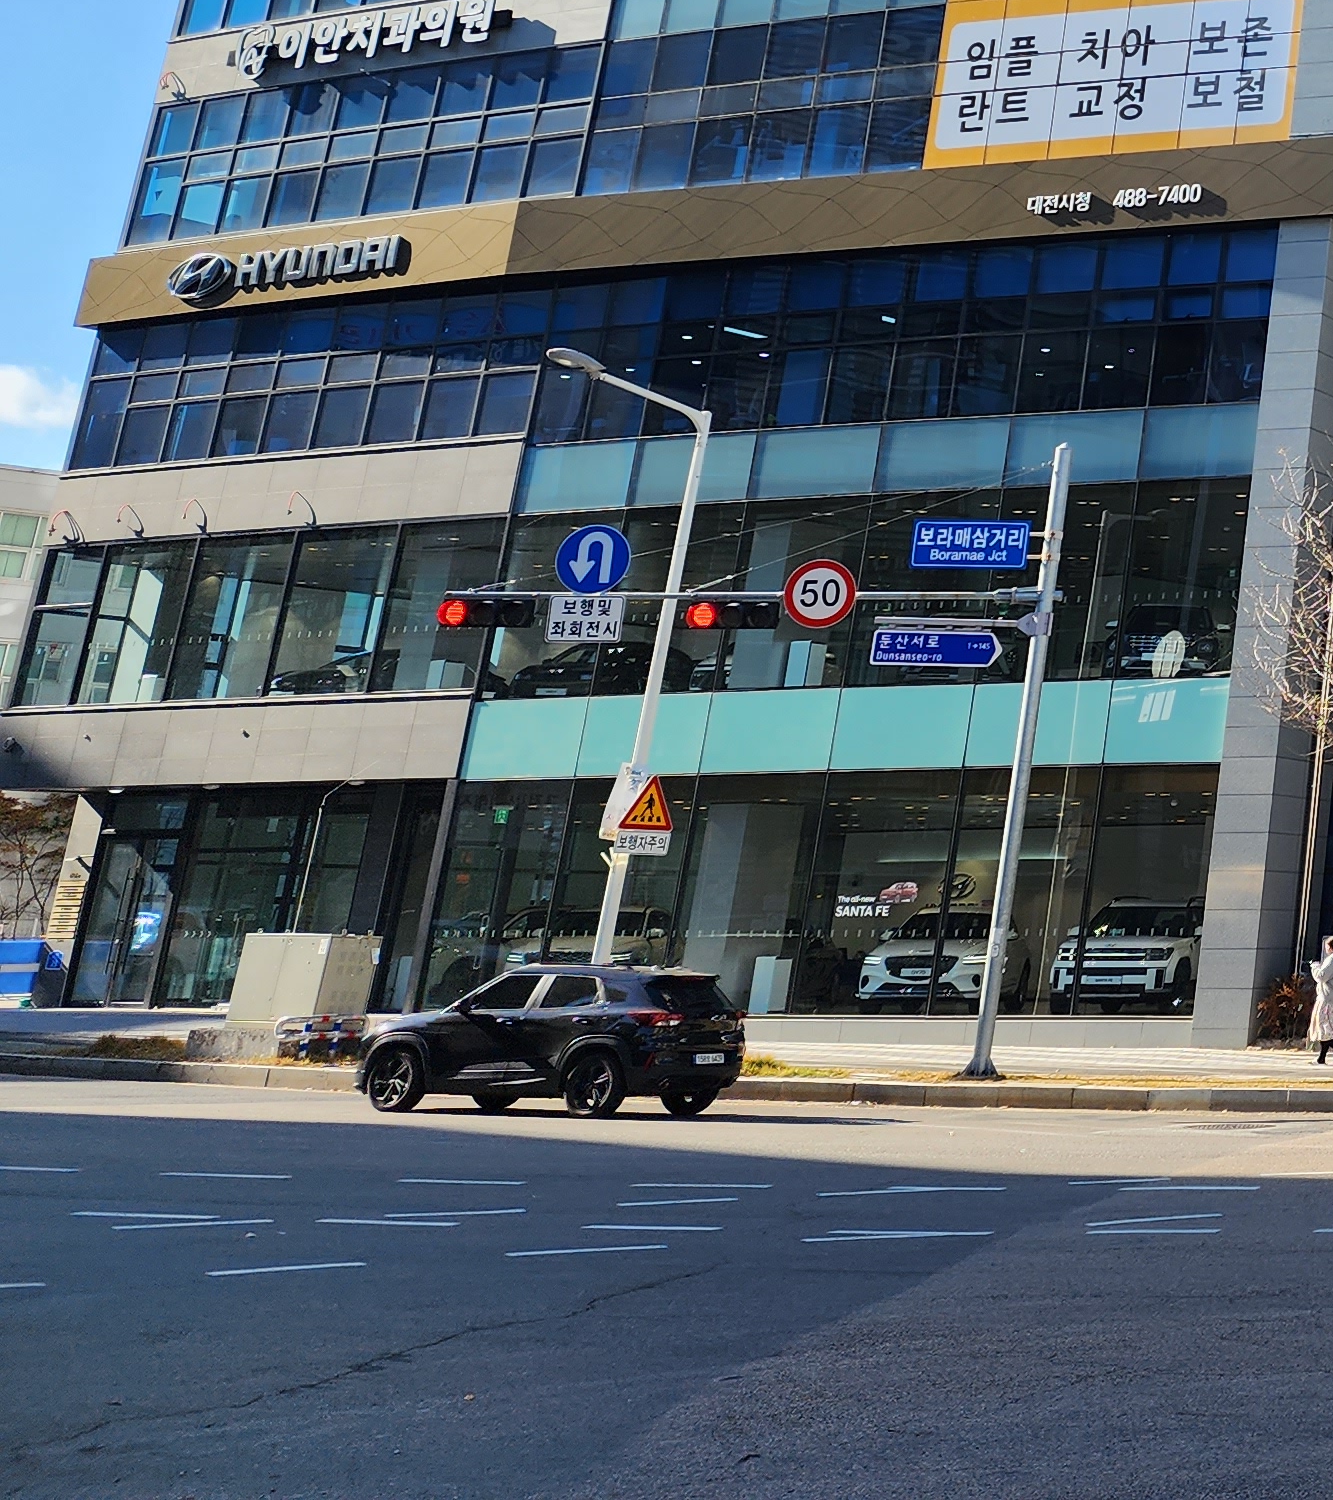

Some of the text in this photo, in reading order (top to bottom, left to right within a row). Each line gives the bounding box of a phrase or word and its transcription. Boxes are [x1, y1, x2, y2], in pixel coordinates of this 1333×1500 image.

[1077, 25, 1156, 69] 치아
[1192, 16, 1274, 58] 보존
[1068, 80, 1147, 121] 교정
[1186, 70, 1266, 113] 보철
[1026, 183, 1202, 215] 대전시청 488-7400
[234, 235, 402, 288] HYUNDAI
[917, 527, 1025, 549] 보라매삼거리
[930, 549, 1007, 561] Boramae Jct
[799, 578, 841, 608] 50
[550, 621, 618, 638] 좌회전시
[879, 635, 940, 649] 둔산서로
[876, 651, 942, 662] Dunsanseo-ro
[617, 835, 668, 851] 보행자주의
[835, 905, 891, 917] SANTA FE
